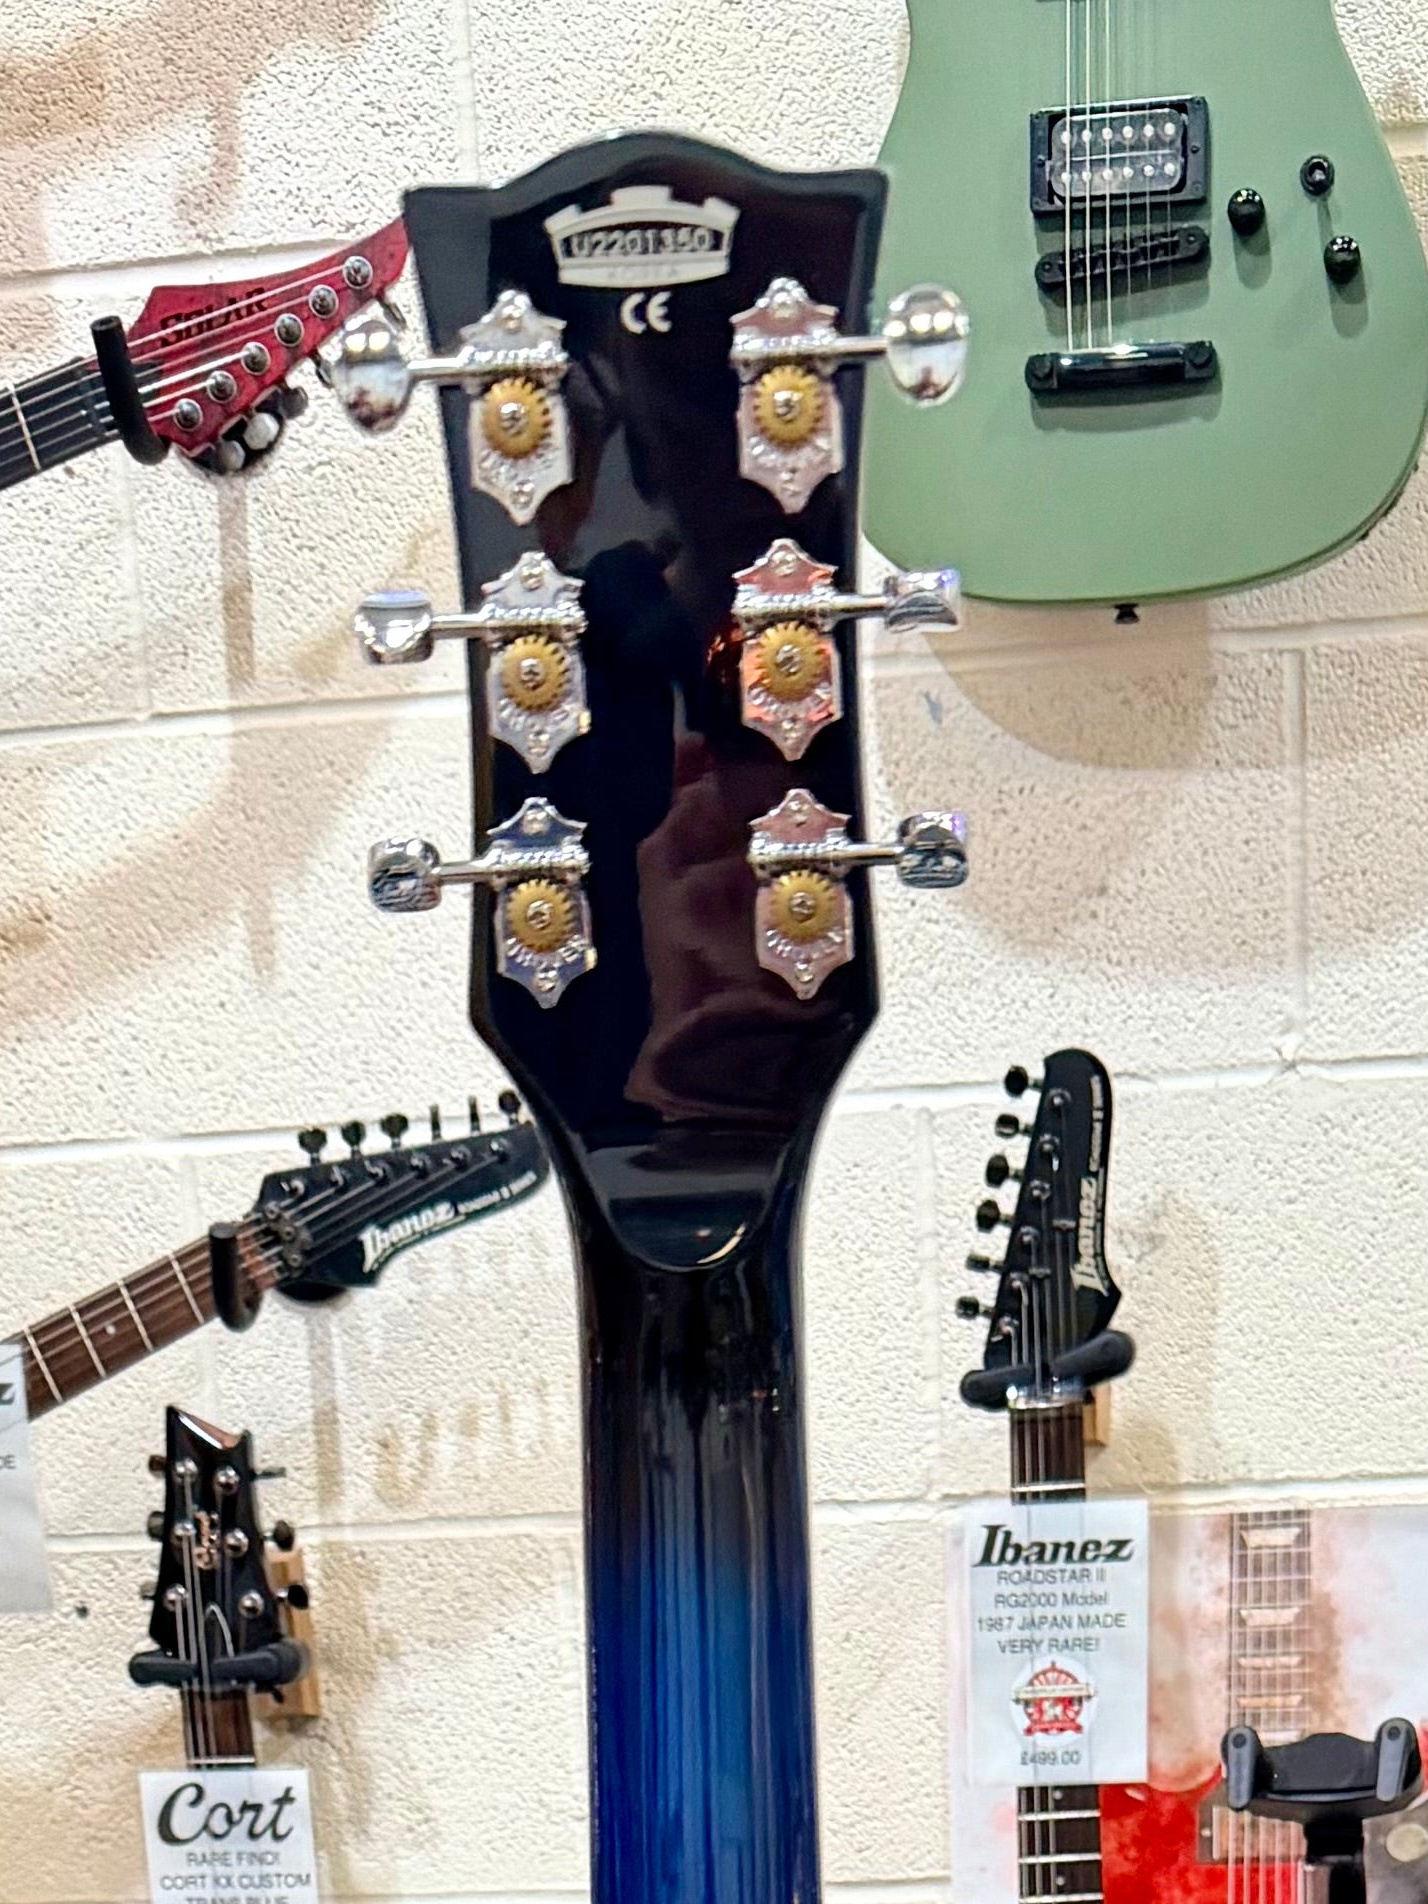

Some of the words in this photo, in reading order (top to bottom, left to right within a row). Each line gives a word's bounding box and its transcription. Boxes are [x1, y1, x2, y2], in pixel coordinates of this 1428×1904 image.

[160, 287, 268, 348] SOLAR
[973, 1524, 1134, 1568] Ibanez
[997, 1569, 1090, 1585] ROADSTAR
[994, 1593, 1058, 1608] RG2000
[1062, 1592, 1108, 1607] Model
[977, 1617, 1015, 1632] 1987
[1018, 1614, 1072, 1631] JAPAN
[1077, 1613, 1127, 1628] MADE
[997, 1640, 1043, 1654] VERY
[1048, 1637, 1100, 1652] RARE!
[157, 1782, 296, 1846] Cort
[187, 1853, 232, 1867] RARE
[160, 1875, 207, 1890] CORT
[239, 1873, 311, 1888] CUSTOM
